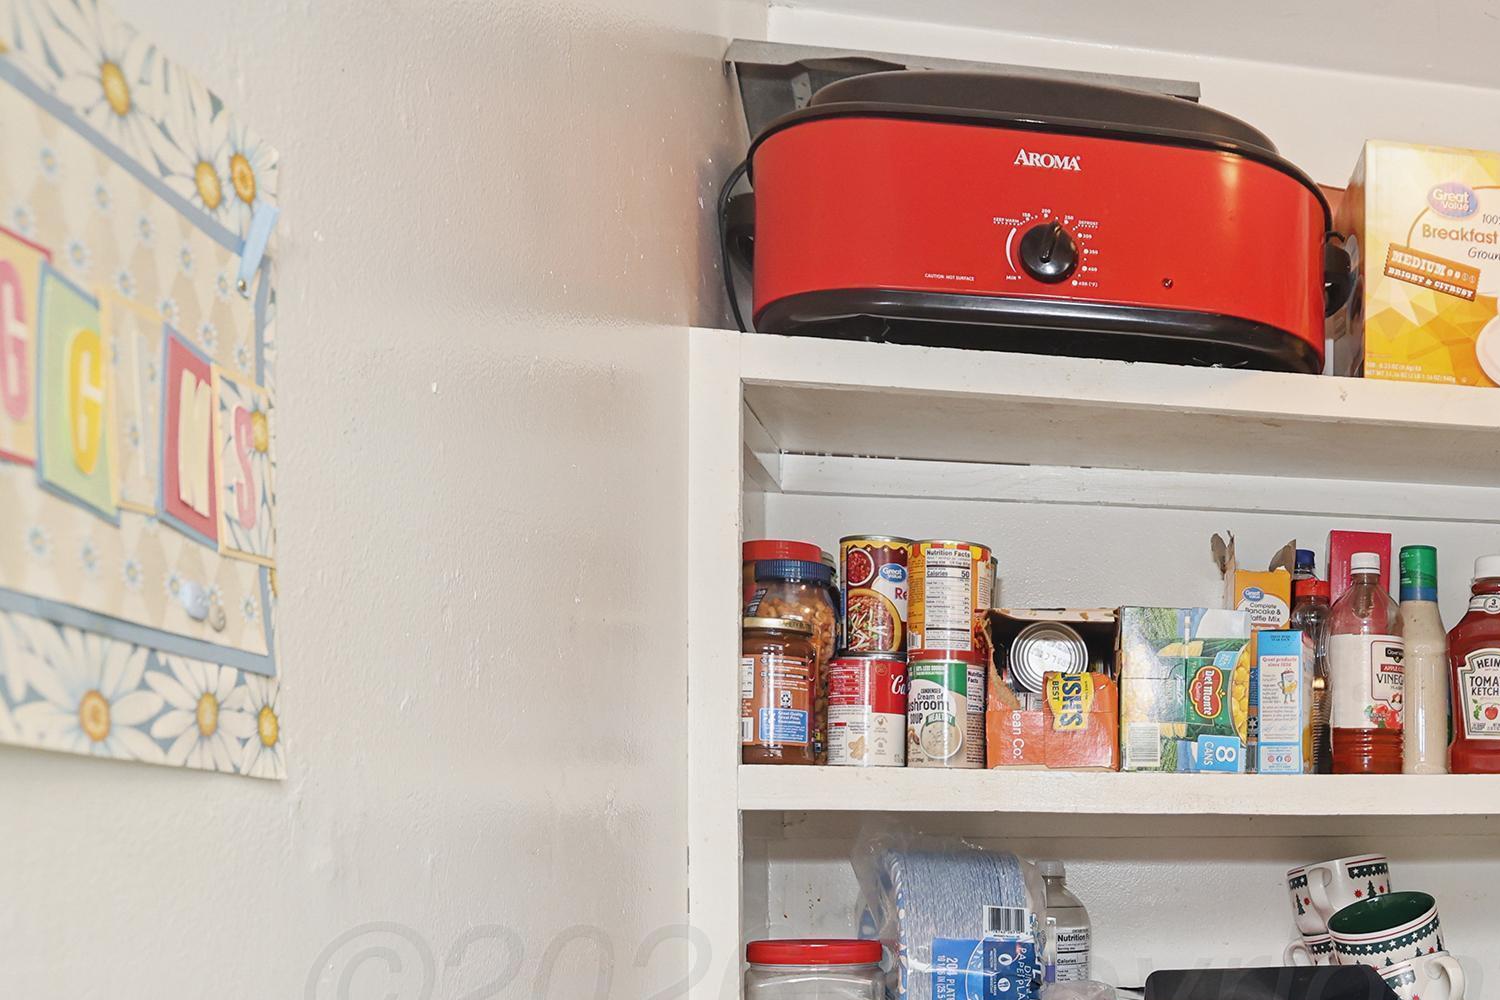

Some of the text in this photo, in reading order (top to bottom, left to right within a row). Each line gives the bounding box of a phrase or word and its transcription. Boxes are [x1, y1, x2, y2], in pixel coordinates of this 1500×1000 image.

[1014, 148, 1081, 172] AROMA
[1433, 188, 1470, 203] Great
[1442, 201, 1470, 211] Value
[1422, 224, 1498, 244] Breakfast
[1391, 251, 1446, 277] MEDIUM
[1388, 267, 1474, 298] BRIGHT CITRUSY
[882, 566, 902, 575] Great
[1249, 602, 1277, 610] Complete
[1268, 615, 1281, 623] Mix
[1052, 680, 1060, 701] BEST
[1202, 669, 1215, 716] Del Monte
[910, 713, 923, 725] SOUP
[1203, 741, 1214, 766] CANS
[1215, 745, 1236, 763] 8
[1056, 934, 1086, 943] Nutrition
